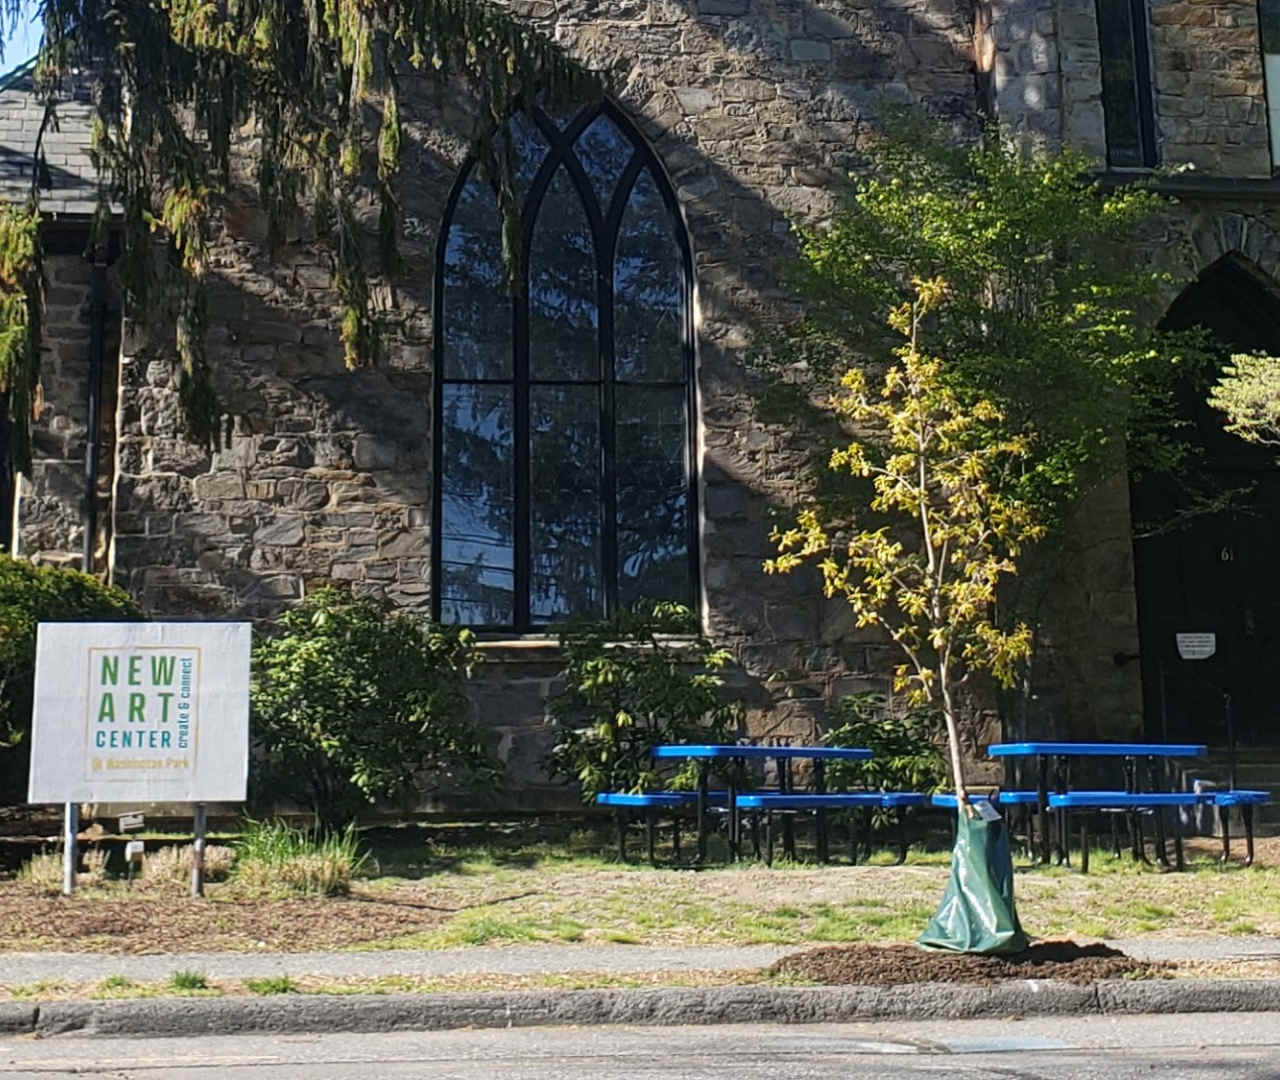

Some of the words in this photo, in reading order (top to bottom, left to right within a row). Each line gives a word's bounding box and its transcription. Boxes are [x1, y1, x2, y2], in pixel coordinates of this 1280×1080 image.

[101, 655, 176, 686] NEW
[180, 657, 192, 699] connect
[98, 692, 175, 723] ART
[178, 702, 190, 710] &
[95, 730, 171, 748] CENTER
[177, 713, 189, 749] create
